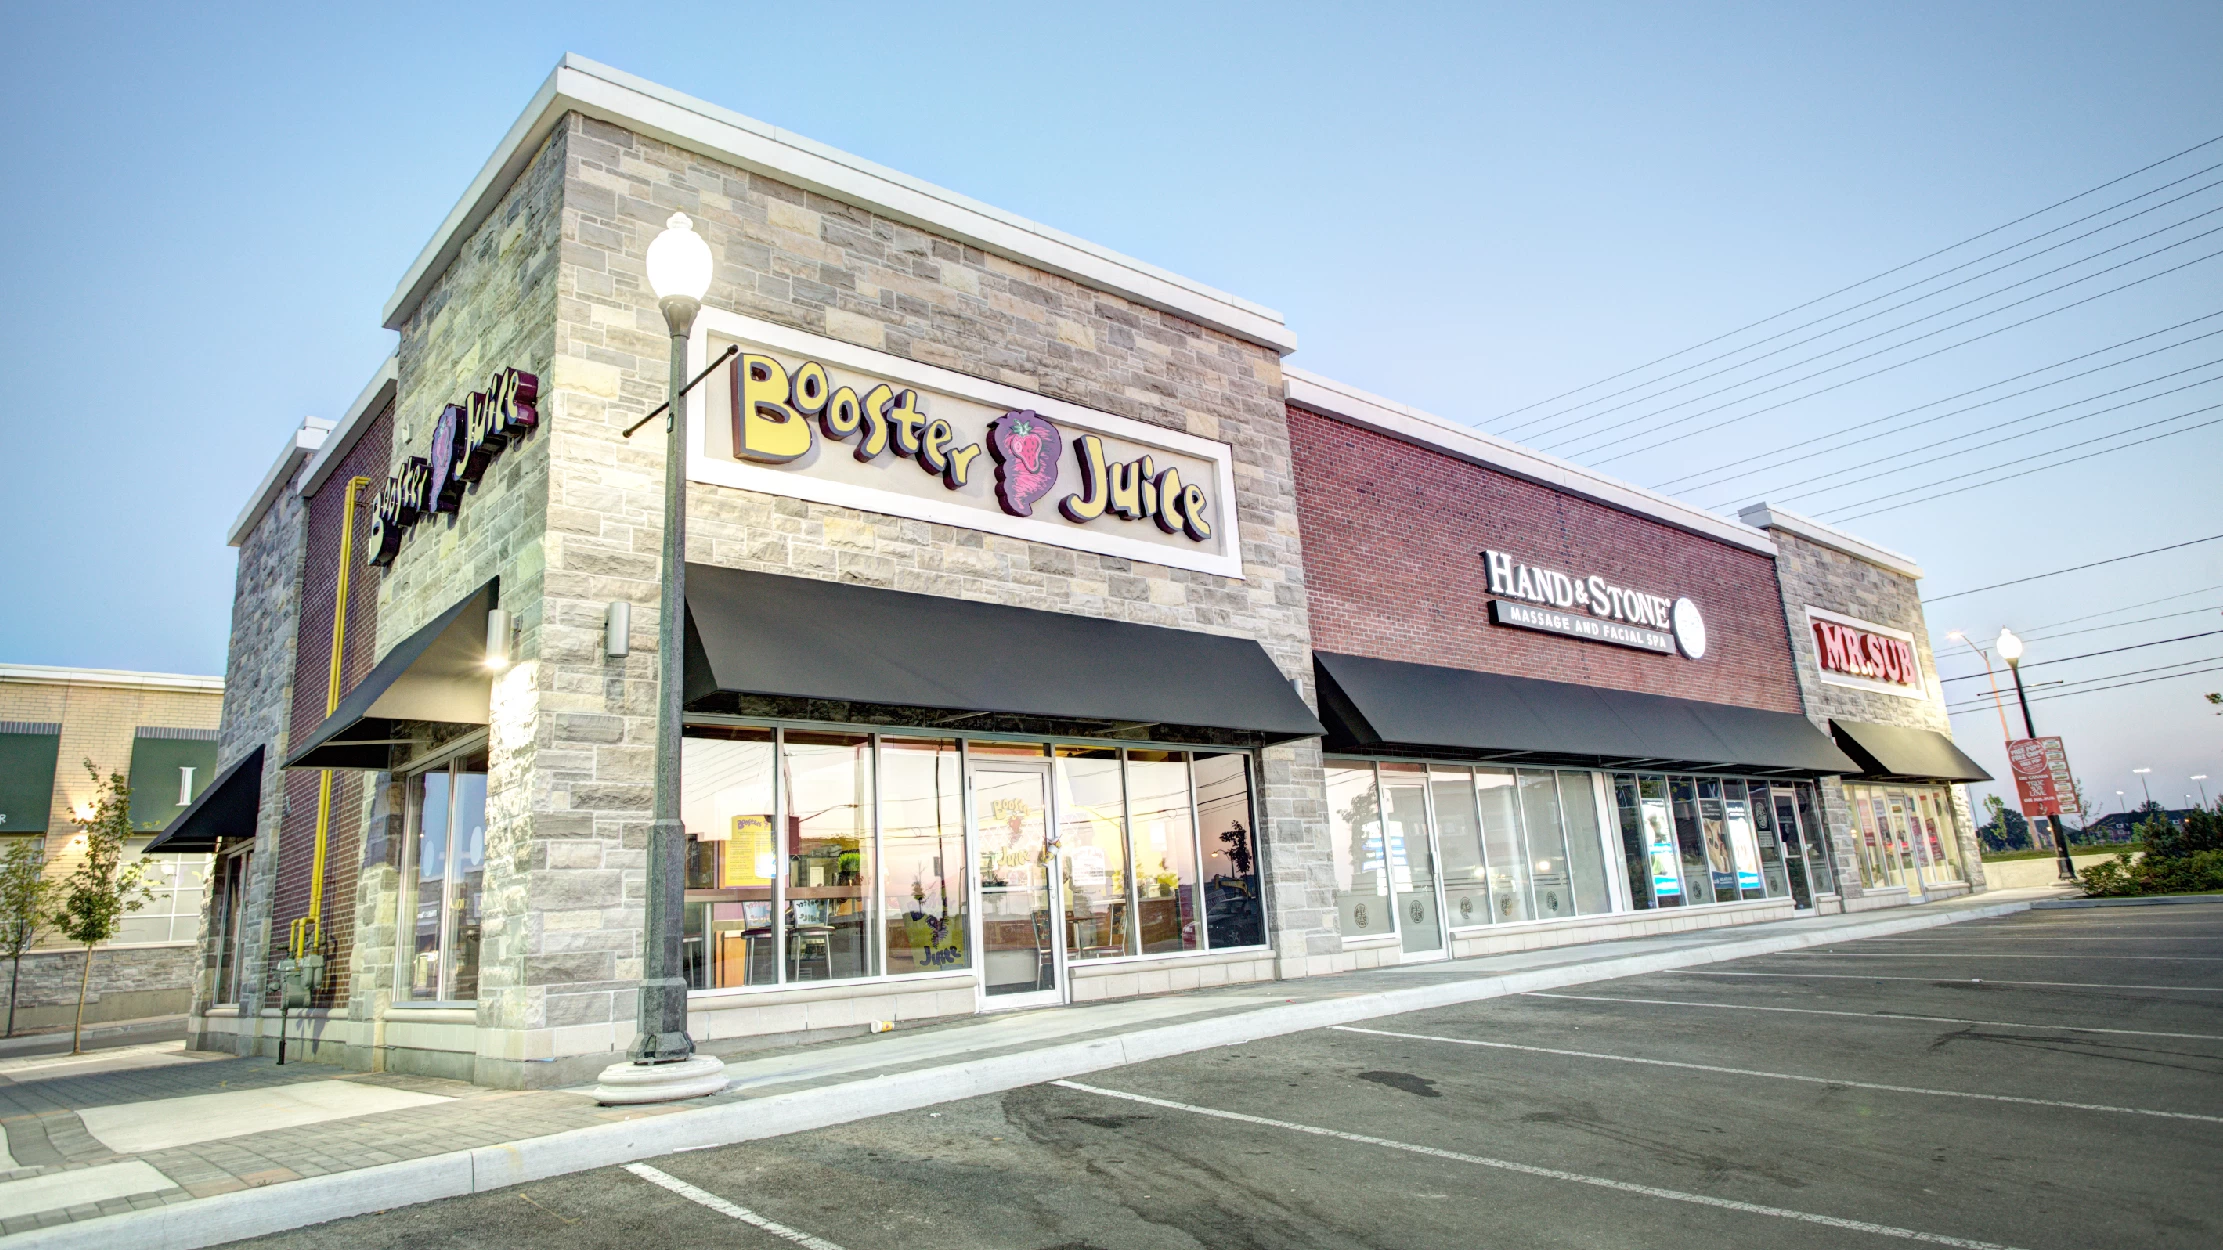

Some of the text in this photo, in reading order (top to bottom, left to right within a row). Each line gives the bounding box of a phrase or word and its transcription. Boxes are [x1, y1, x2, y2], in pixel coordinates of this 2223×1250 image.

[453, 366, 532, 481] Juice
[730, 353, 1212, 541] Booster Juice
[1509, 606, 1667, 649] MASSAGE AND FACIAL SPA
